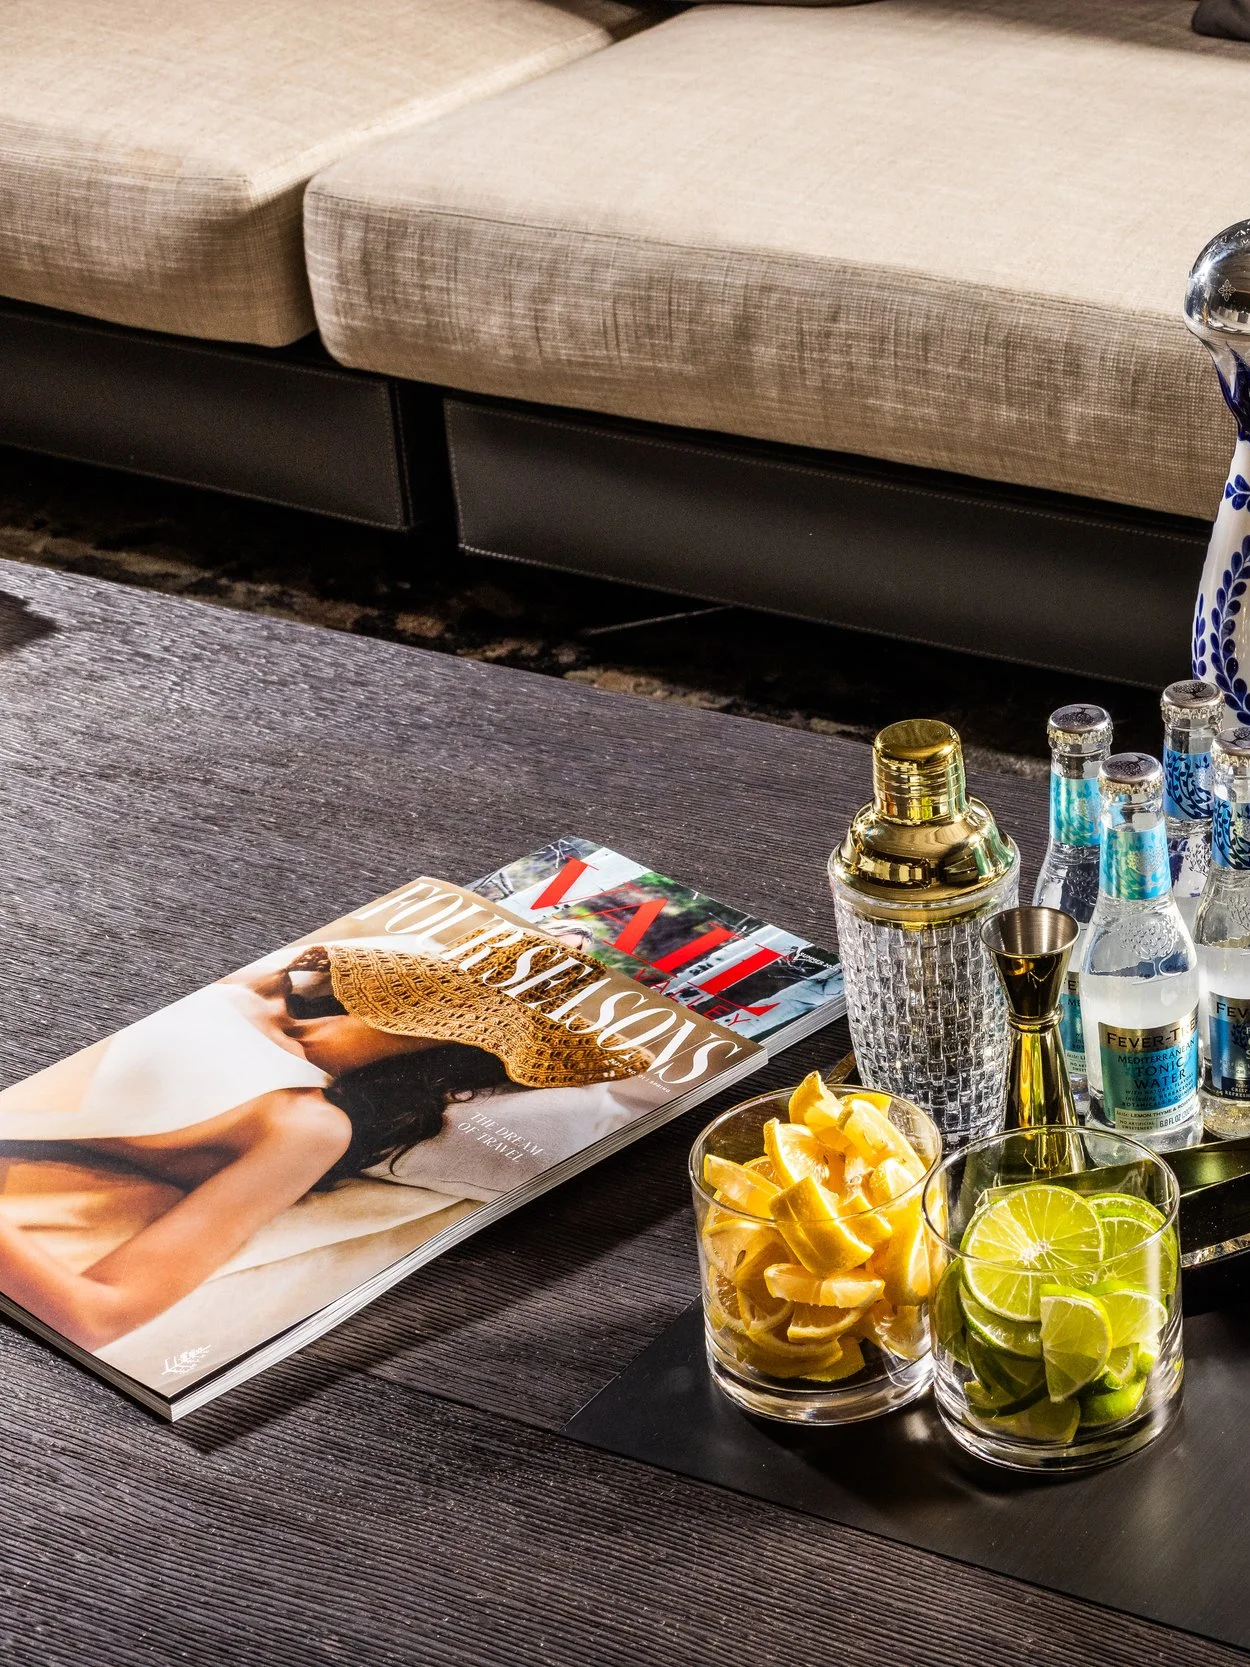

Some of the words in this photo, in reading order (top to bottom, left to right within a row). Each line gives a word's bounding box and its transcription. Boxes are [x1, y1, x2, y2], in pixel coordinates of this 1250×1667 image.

[530, 854, 799, 1018] VAIL
[355, 882, 524, 971] FOUR
[481, 944, 743, 1085] SEASONS
[635, 968, 751, 1028] VALLEY
[1117, 1037, 1195, 1064] MEDITERRANEAN
[1136, 1056, 1184, 1077] TONIC
[1134, 1068, 1186, 1089] WATER
[457, 1122, 480, 1134] OF
[477, 1132, 524, 1163] TRAVEL
[470, 1111, 499, 1131] THE
[495, 1126, 544, 1156] DREAM
